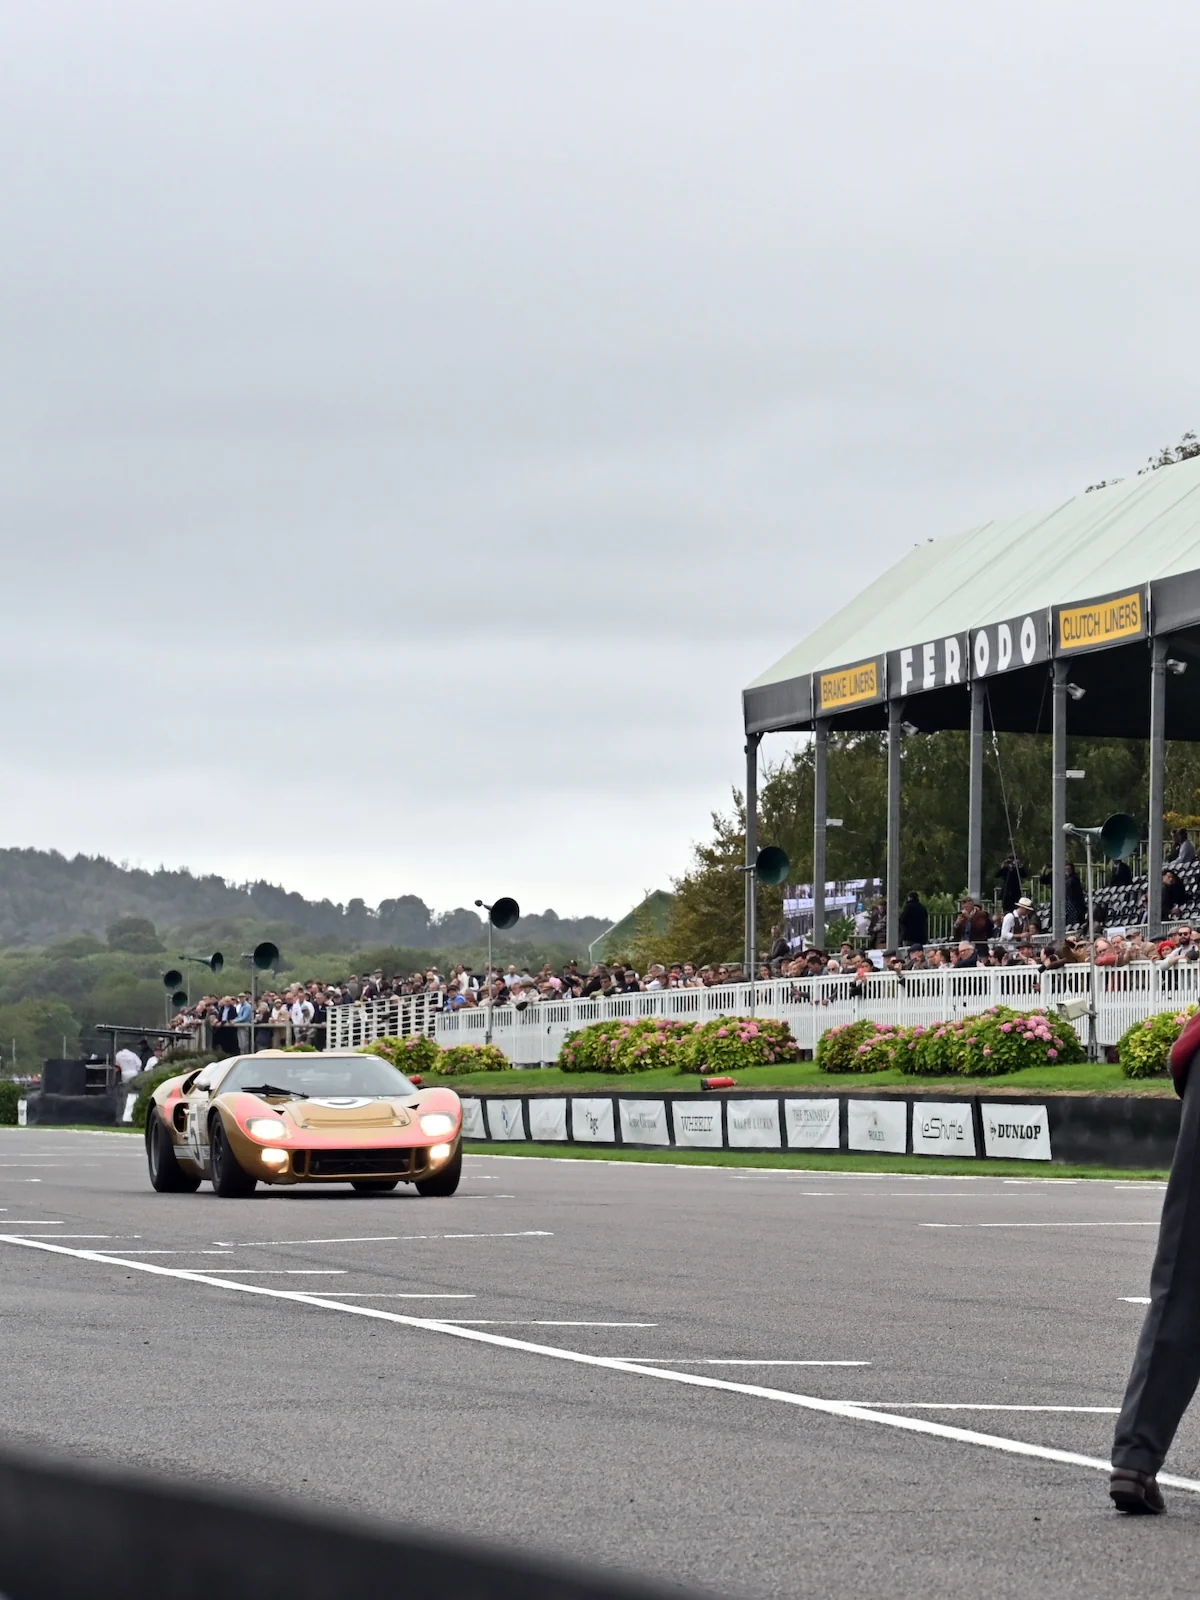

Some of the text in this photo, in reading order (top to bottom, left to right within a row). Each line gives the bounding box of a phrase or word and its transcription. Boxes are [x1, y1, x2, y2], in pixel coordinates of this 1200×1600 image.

[1063, 601, 1138, 641] CLUTCH LINERS
[899, 616, 1037, 696] FERODO
[823, 669, 875, 702] BRAKE LINERS
[998, 1123, 1042, 1140] DUNLOP
